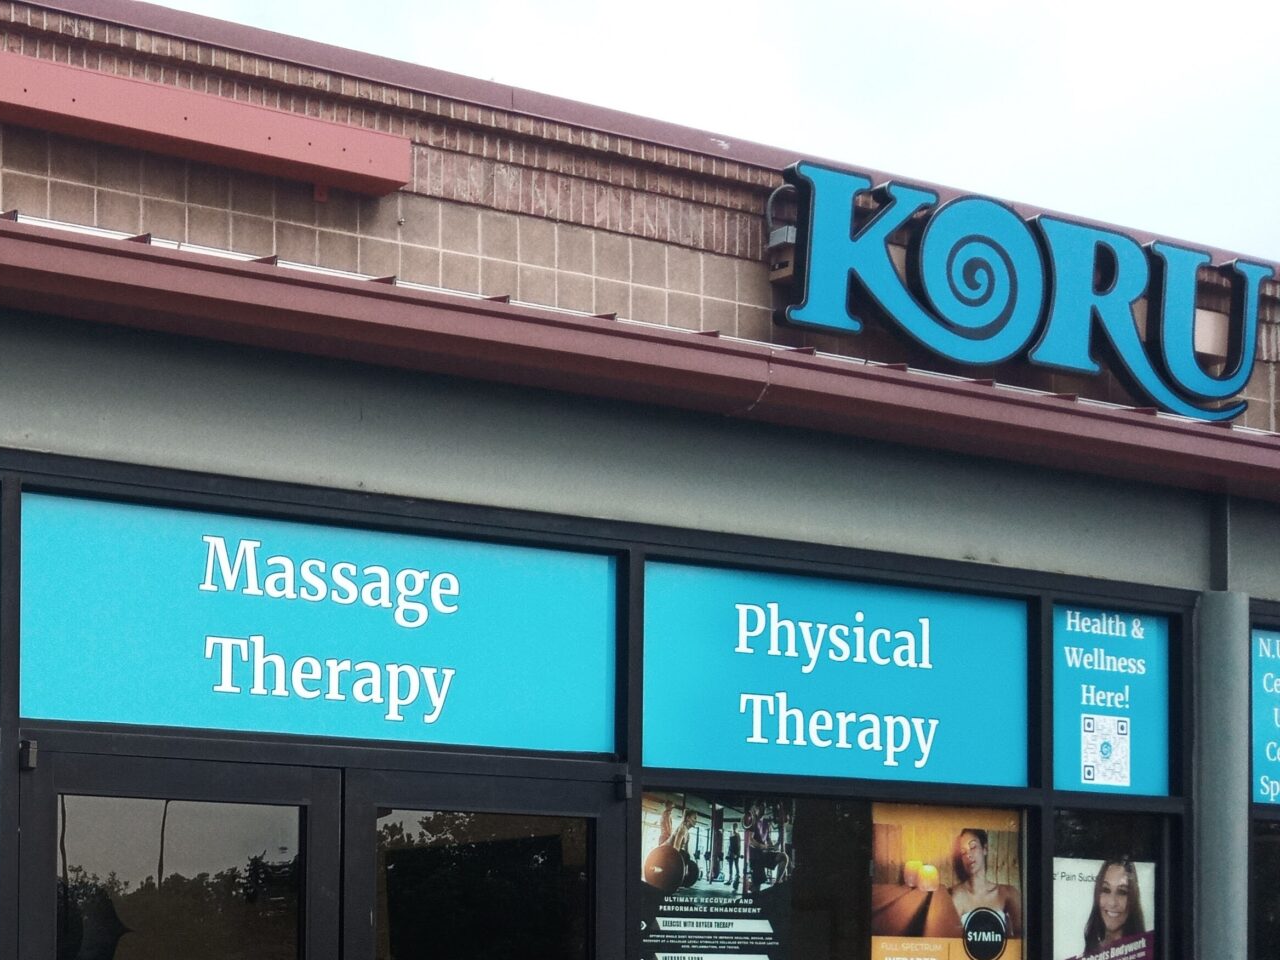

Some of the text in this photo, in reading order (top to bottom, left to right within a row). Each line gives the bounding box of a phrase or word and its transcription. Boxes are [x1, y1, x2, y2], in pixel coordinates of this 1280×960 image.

[785, 160, 1275, 421] KORU
[198, 534, 460, 628] Massage
[734, 602, 933, 674] Physical
[1066, 610, 1144, 639] Health &
[1064, 646, 1146, 675] Wellness
[204, 634, 456, 724] Therapy
[1081, 684, 1130, 709] Here!
[739, 691, 939, 768] Therapy
[1061, 872, 1077, 881] Pain
[901, 943, 943, 951] SPECTRUM
[967, 931, 1002, 942] $1/Min
